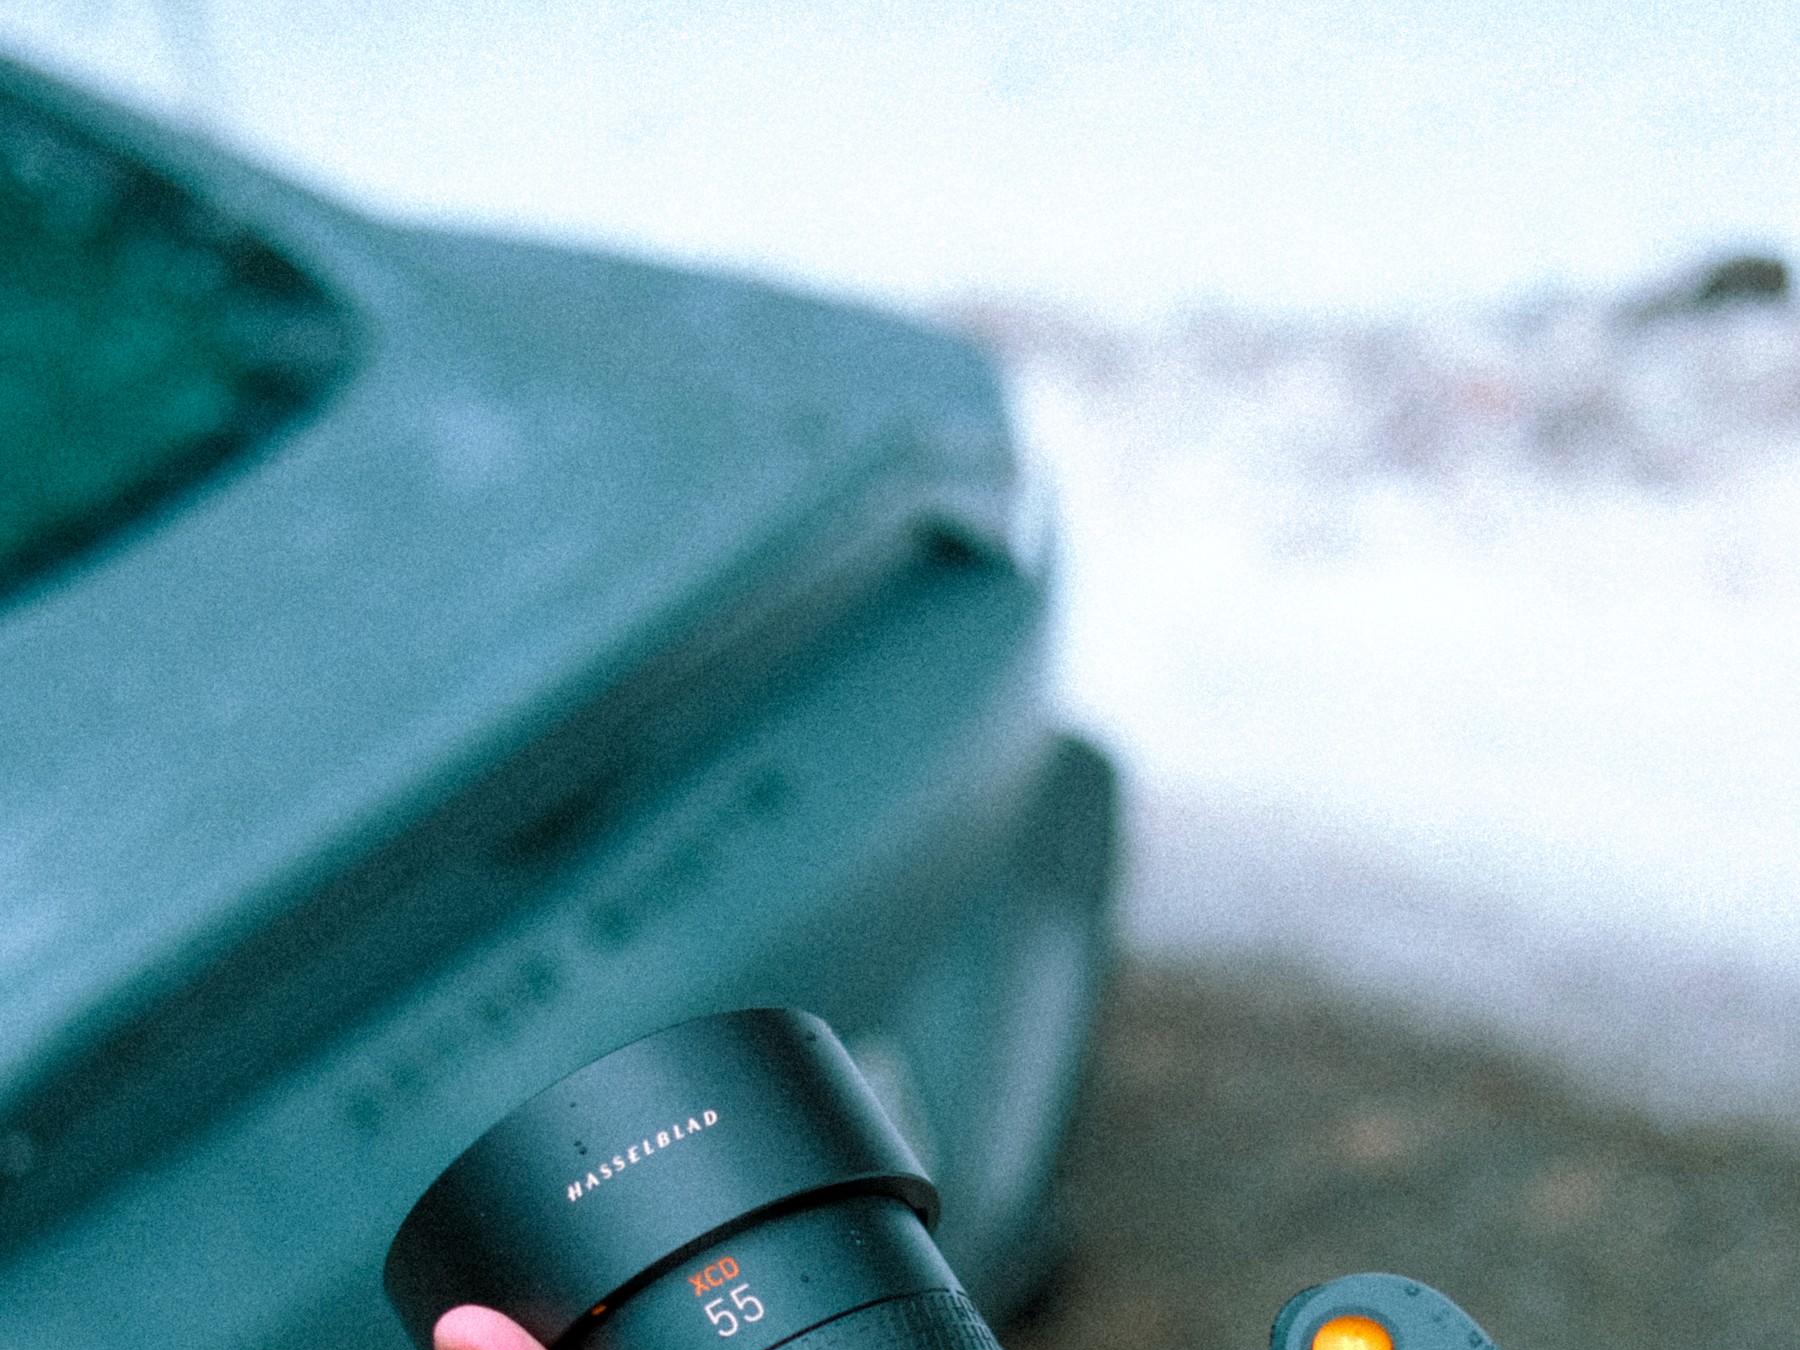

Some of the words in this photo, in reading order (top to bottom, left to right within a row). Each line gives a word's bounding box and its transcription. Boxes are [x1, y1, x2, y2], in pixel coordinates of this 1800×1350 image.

[567, 1109, 719, 1202] HASSELBLAD
[689, 1257, 740, 1296] XCD
[704, 1283, 764, 1337] 55
